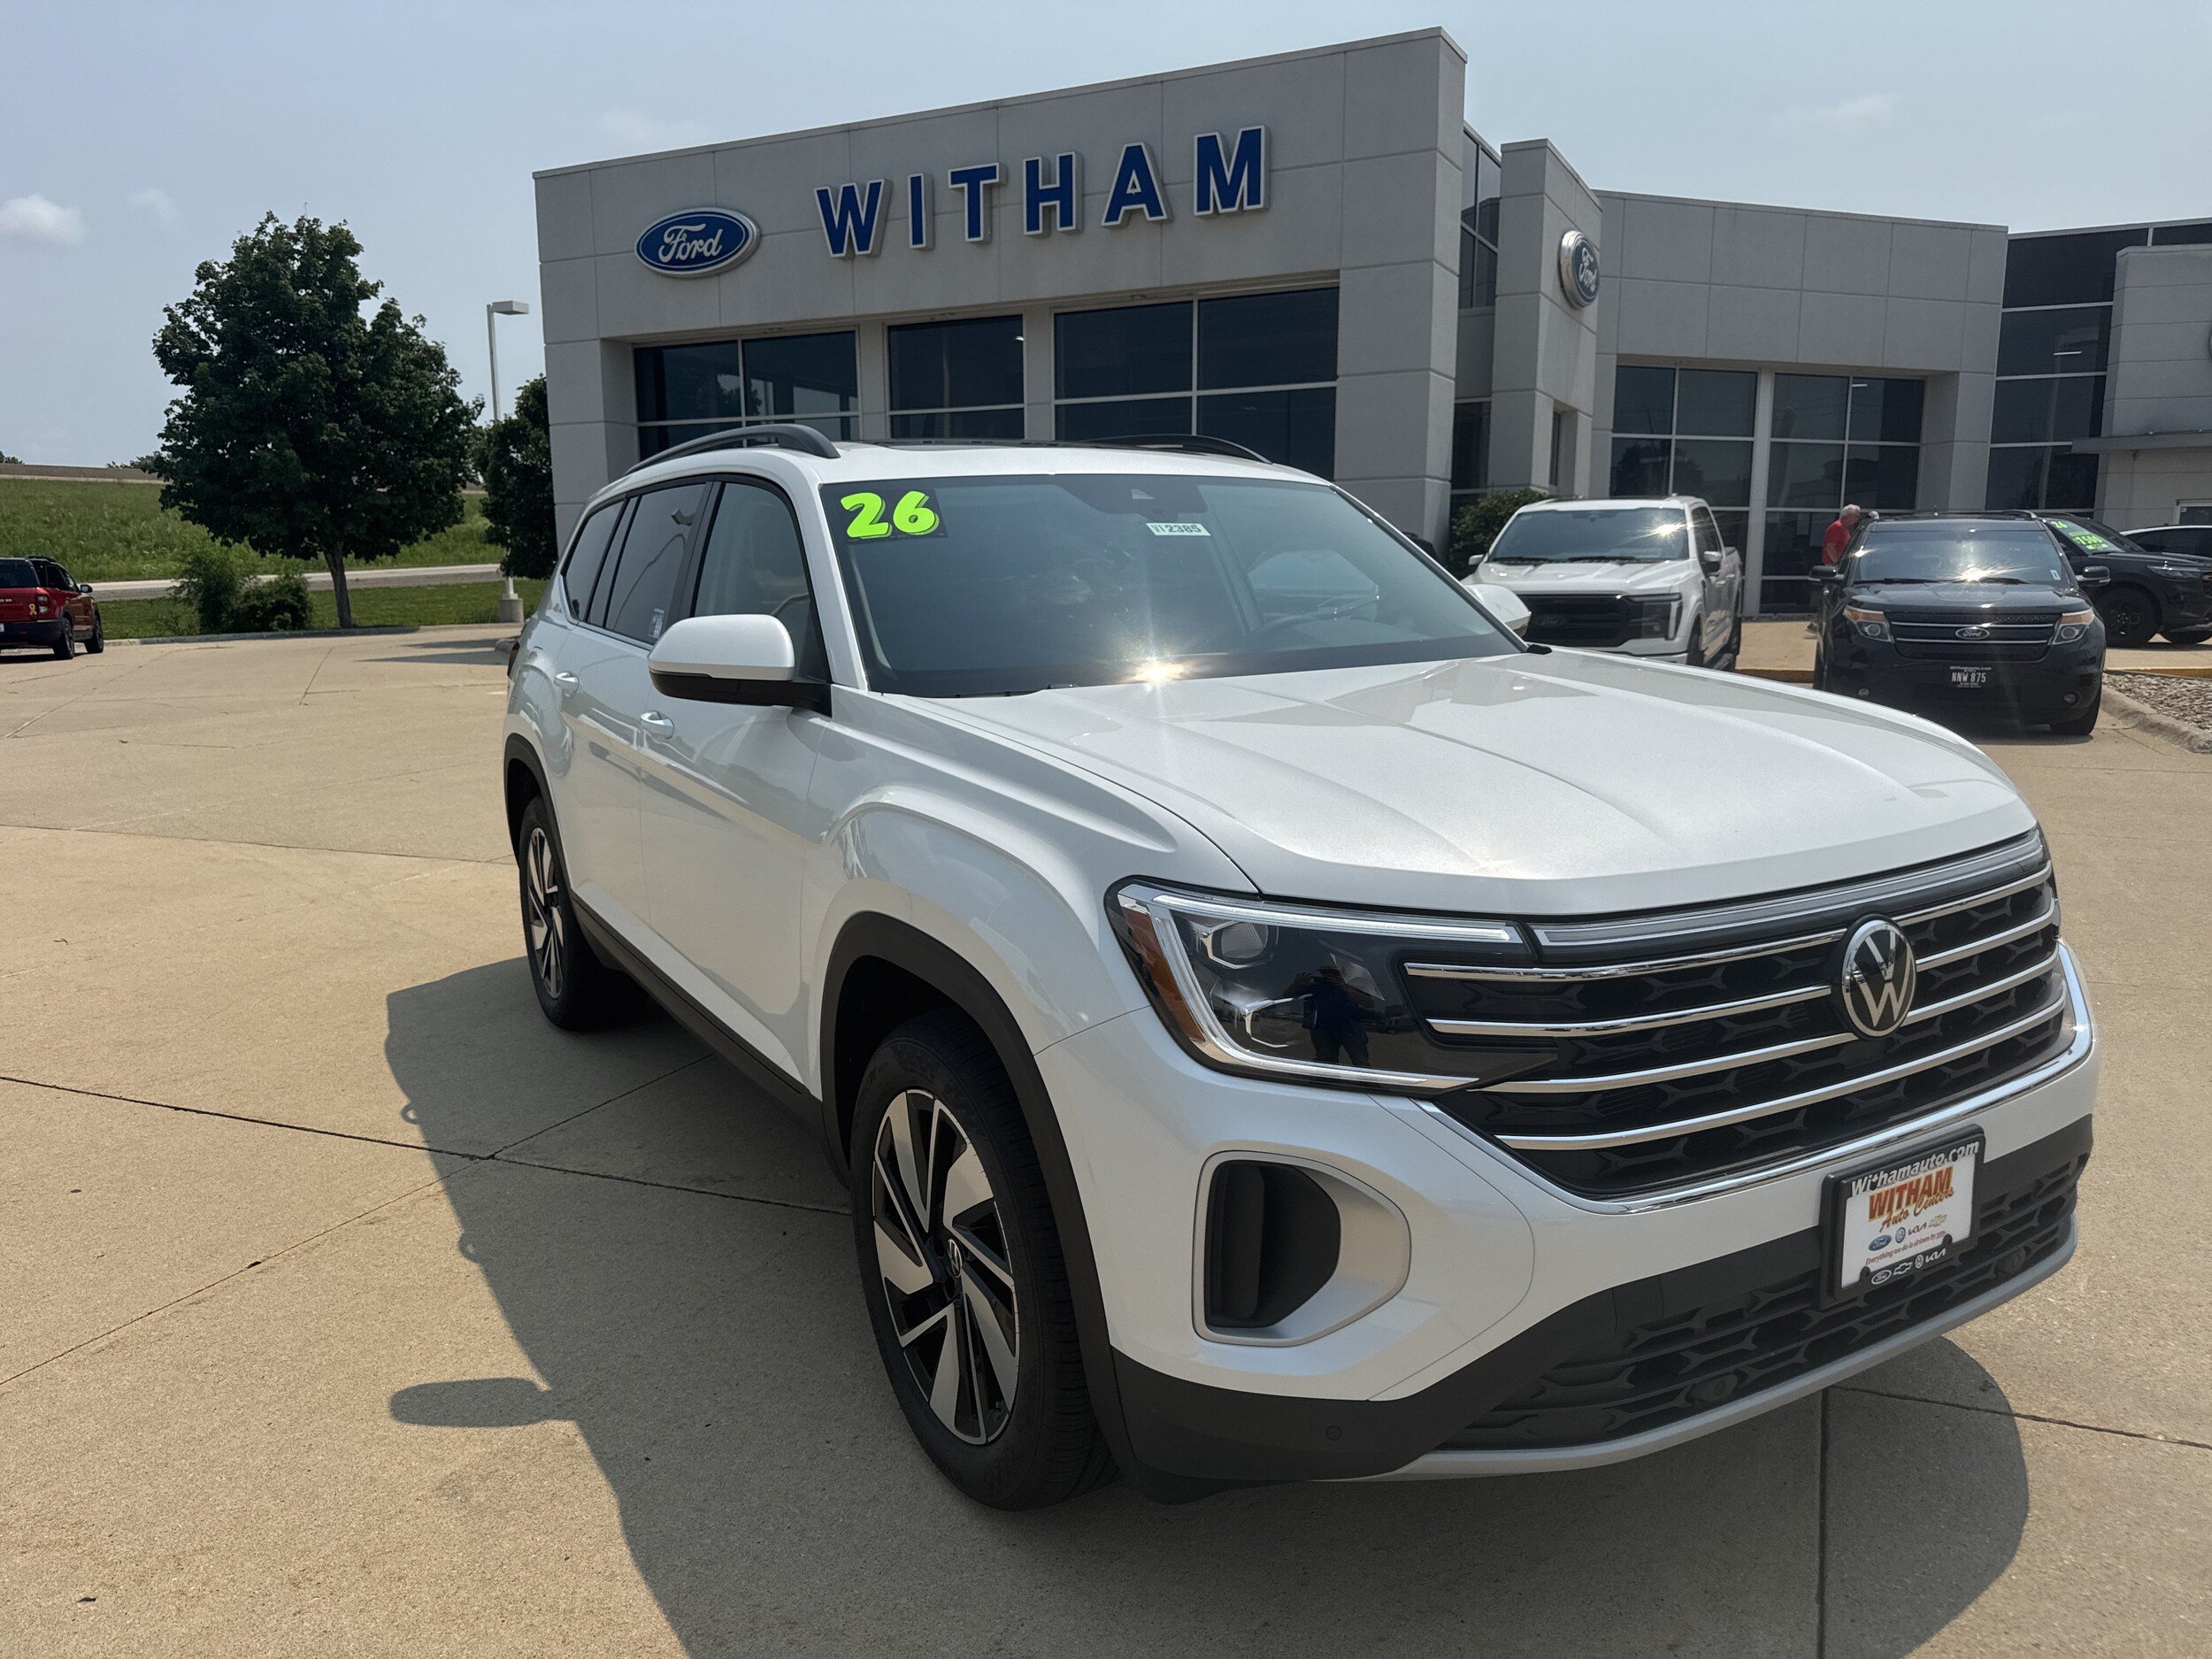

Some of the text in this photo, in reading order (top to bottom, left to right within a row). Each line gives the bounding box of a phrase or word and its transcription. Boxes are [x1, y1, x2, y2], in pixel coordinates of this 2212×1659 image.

[813, 125, 1270, 259] WITHAM
[657, 222, 724, 264] Ford
[840, 490, 941, 540] 26
[1962, 628, 1982, 637] Ford
[1970, 672, 1986, 683] 875
[1868, 1164, 1954, 1222] WITHAM
[1878, 1207, 1910, 1233] Auto
